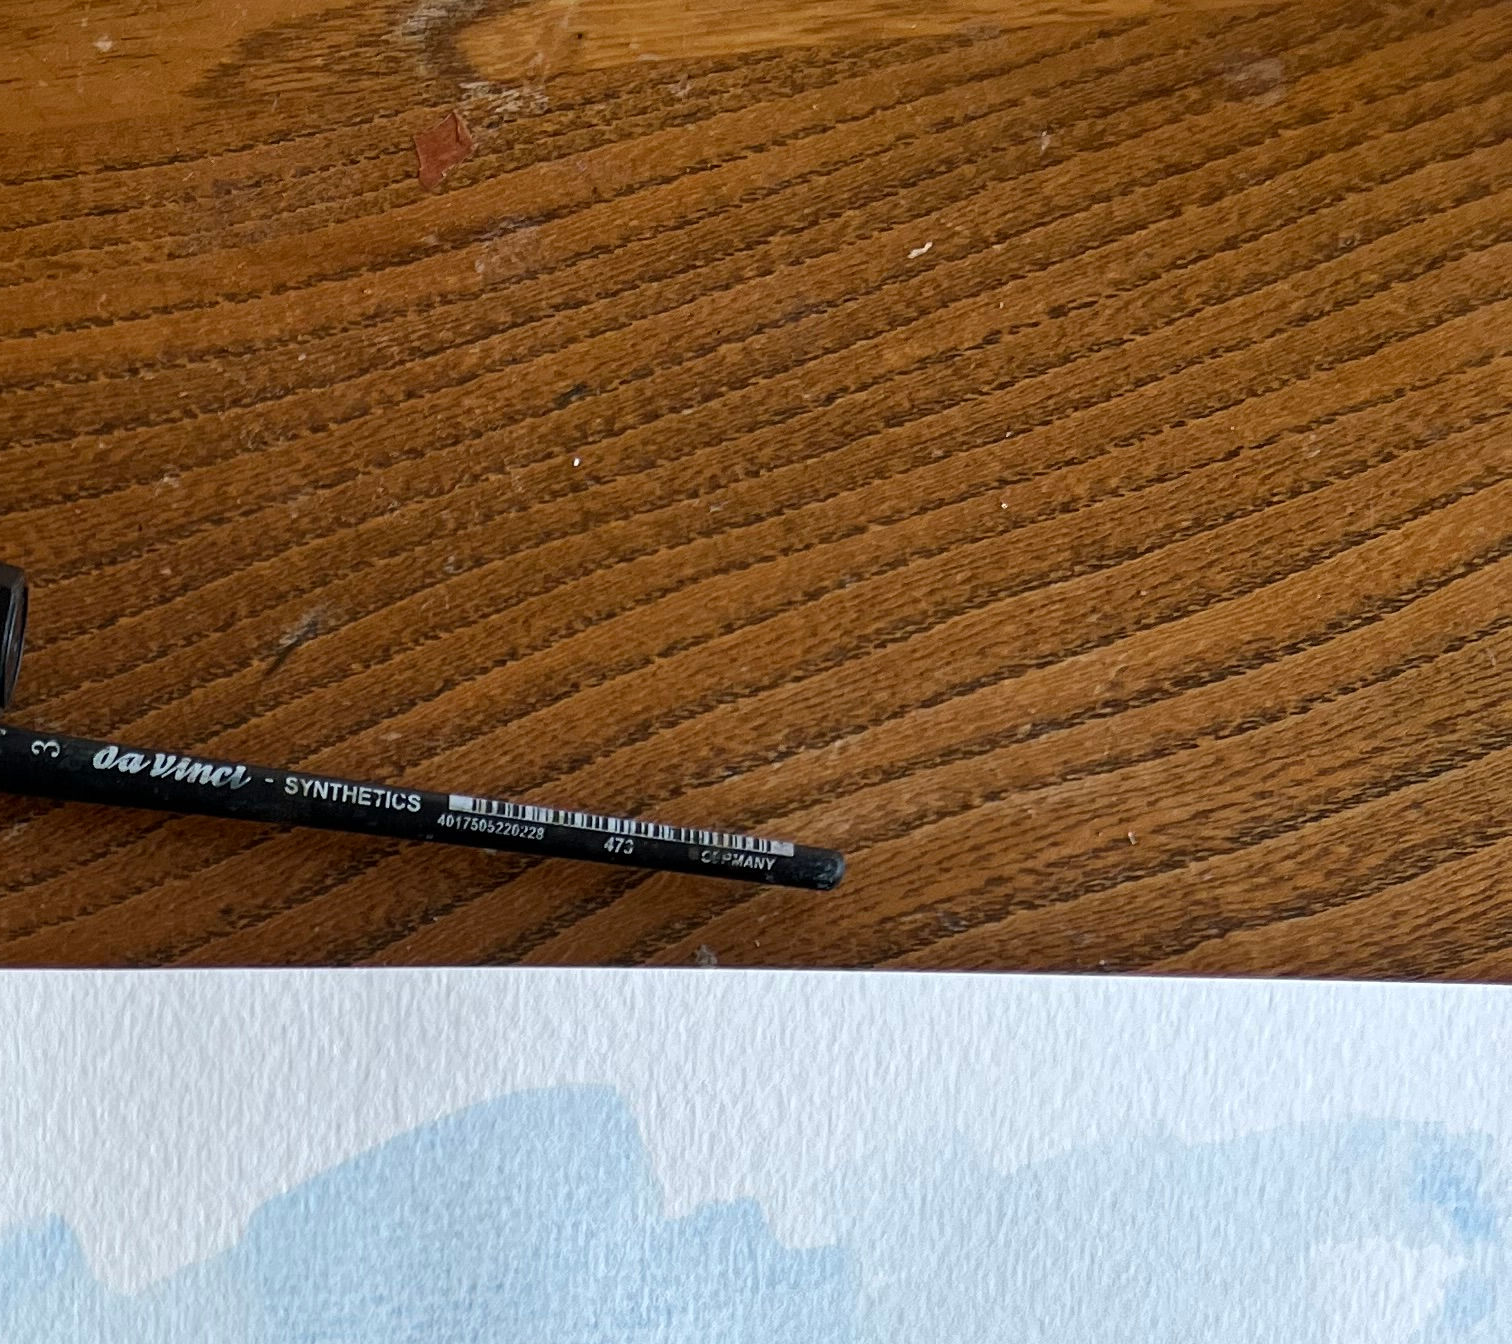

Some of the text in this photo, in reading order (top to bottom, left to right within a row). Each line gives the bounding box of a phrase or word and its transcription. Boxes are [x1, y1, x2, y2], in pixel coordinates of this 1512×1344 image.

[31, 740, 60, 758] 3
[284, 777, 422, 813] SYNTHETICS
[603, 836, 635, 855] 473
